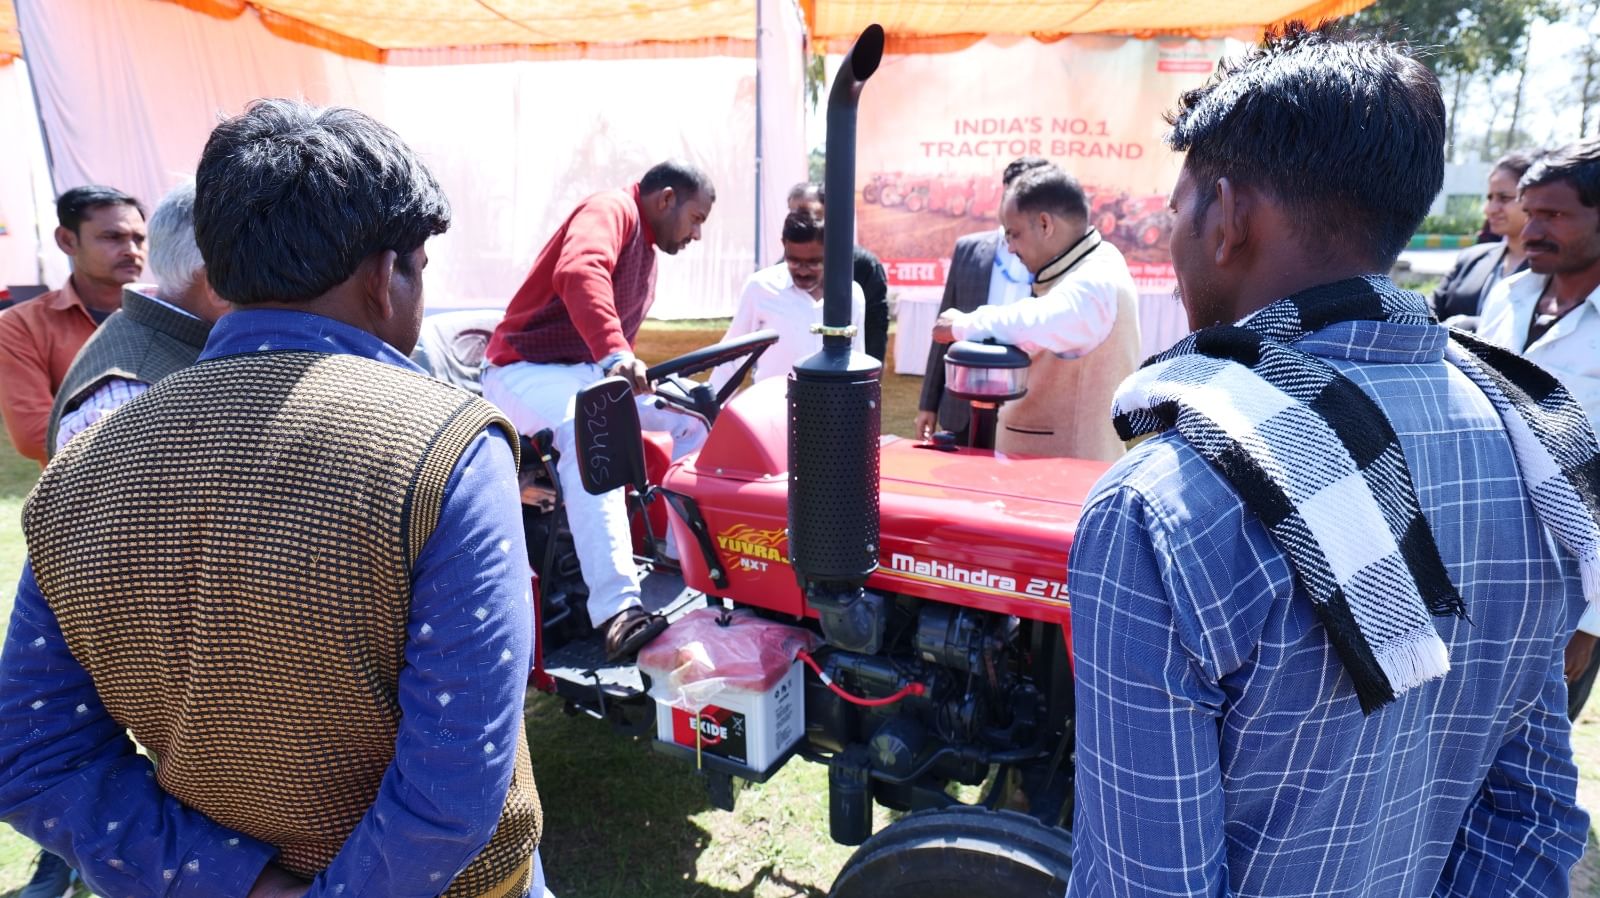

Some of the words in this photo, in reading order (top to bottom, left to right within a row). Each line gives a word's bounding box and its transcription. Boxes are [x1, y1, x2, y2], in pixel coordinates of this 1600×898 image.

[954, 117, 1043, 135] INDIA'S
[1051, 118, 1110, 136] NO.1
[920, 139, 1042, 157] TRACTOR
[1051, 140, 1144, 160] BRAND
[740, 557, 768, 572] NXT
[891, 552, 1016, 592] Mahindra
[688, 717, 728, 740] EXIDE
